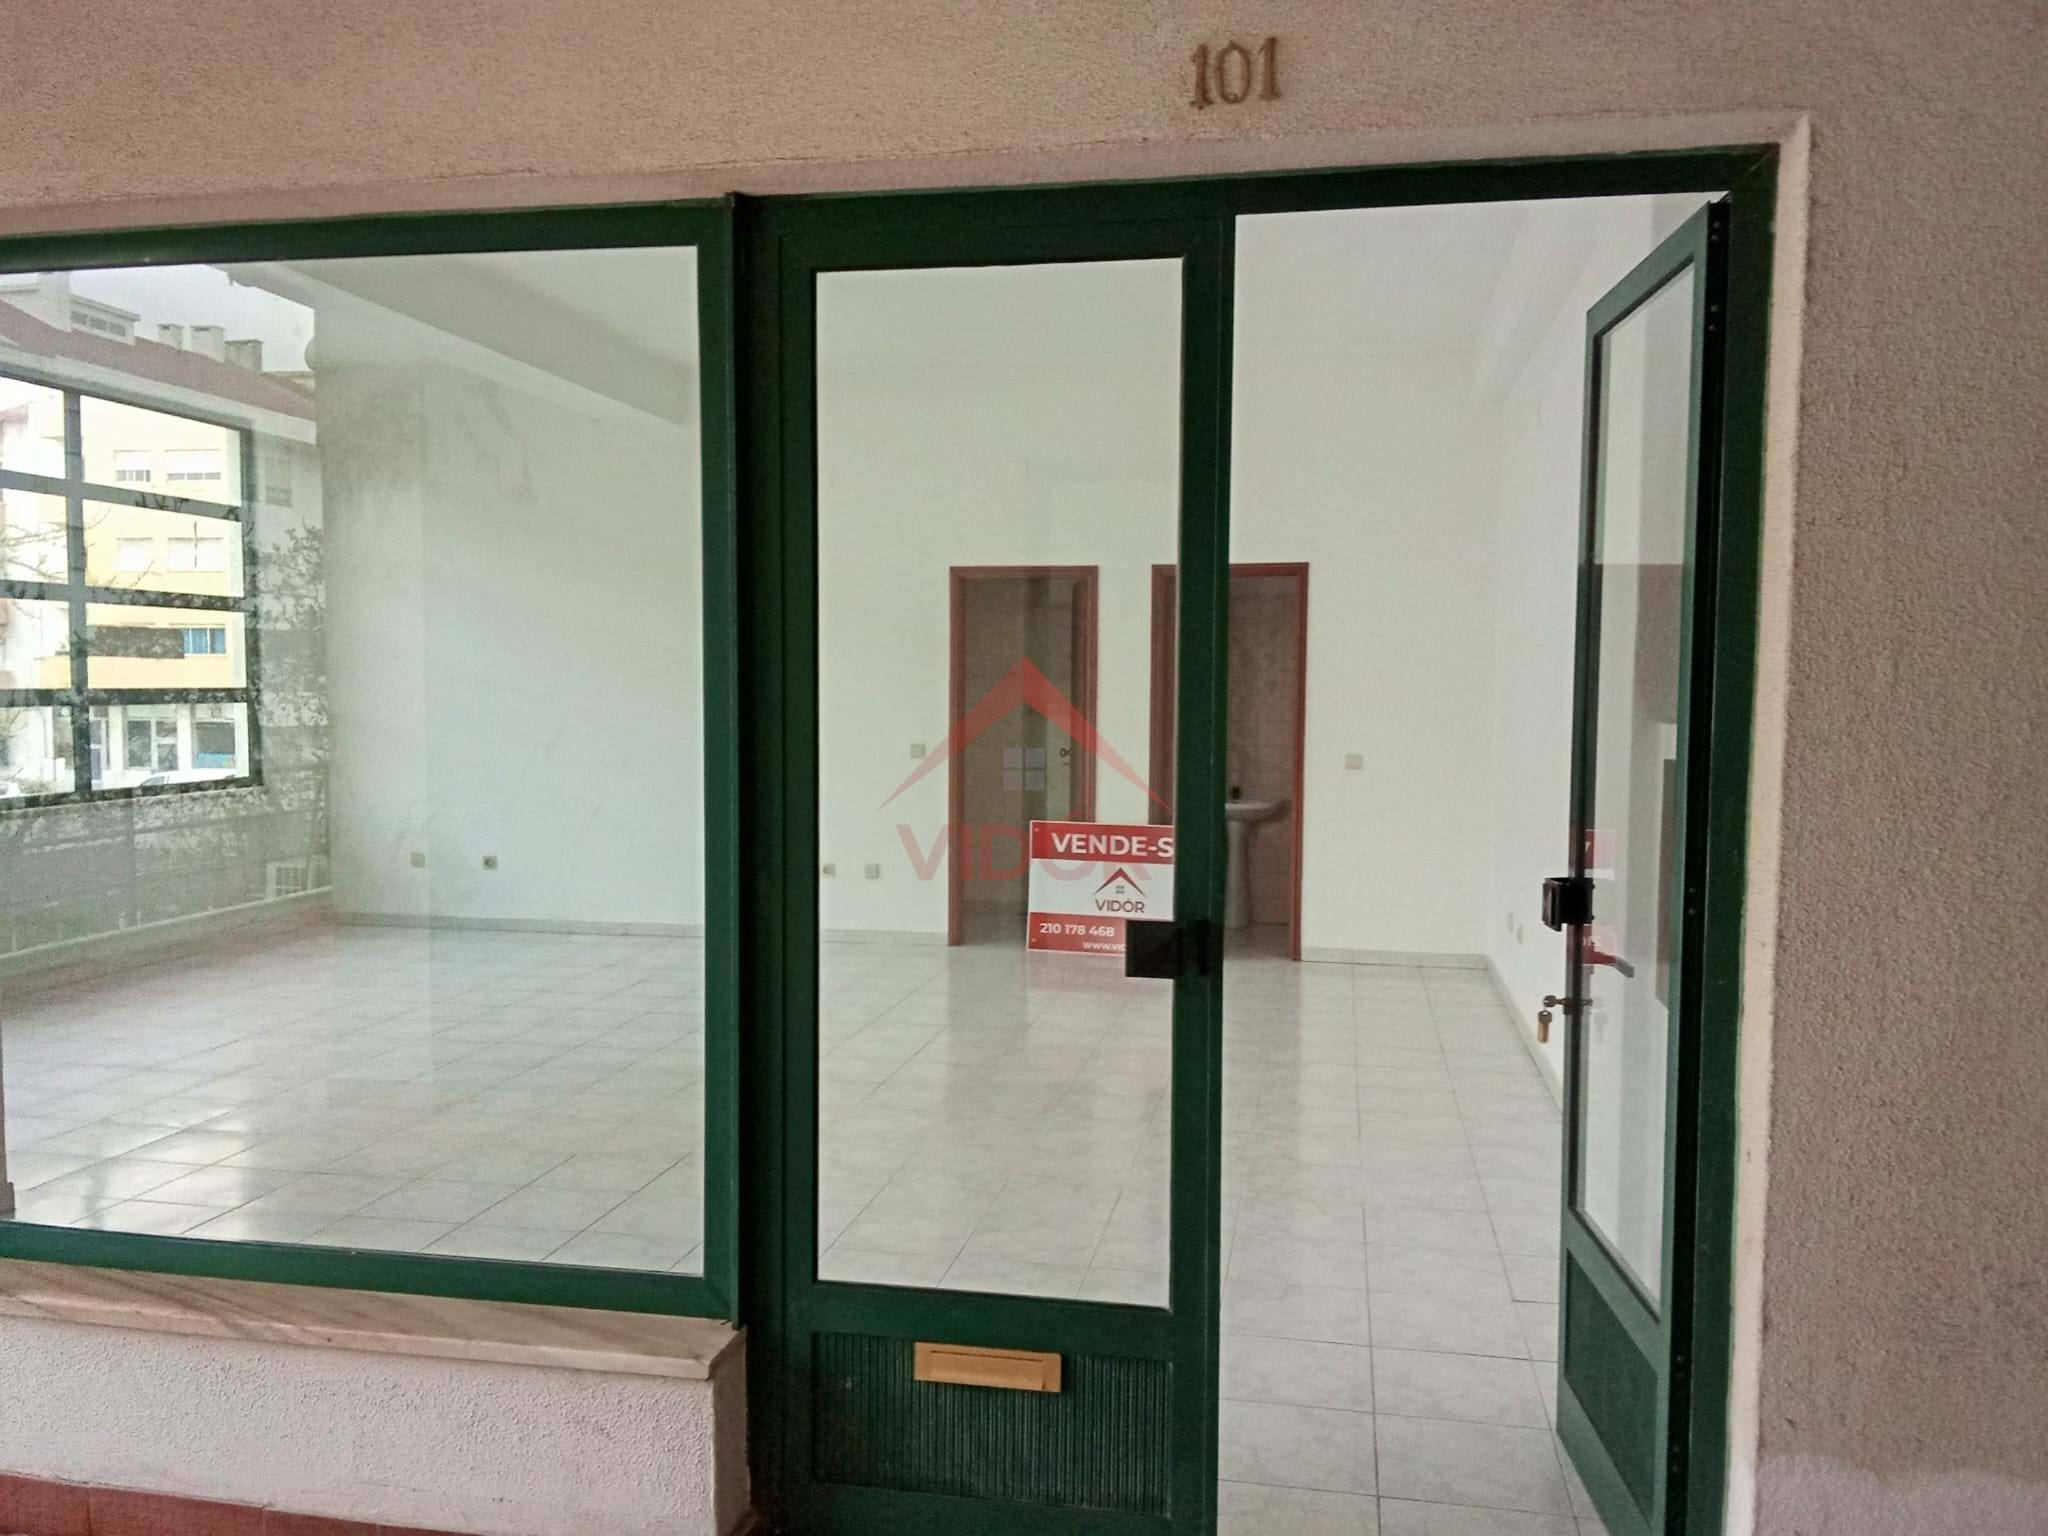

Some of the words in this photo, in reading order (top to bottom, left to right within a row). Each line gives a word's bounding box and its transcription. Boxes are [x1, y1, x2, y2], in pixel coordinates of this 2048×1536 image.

[1189, 37, 1282, 110] 101
[1095, 898, 1145, 914] VIDÓR
[1040, 923, 1061, 934] 210
[1064, 924, 1086, 936] 178
[1089, 926, 1115, 938] 468
